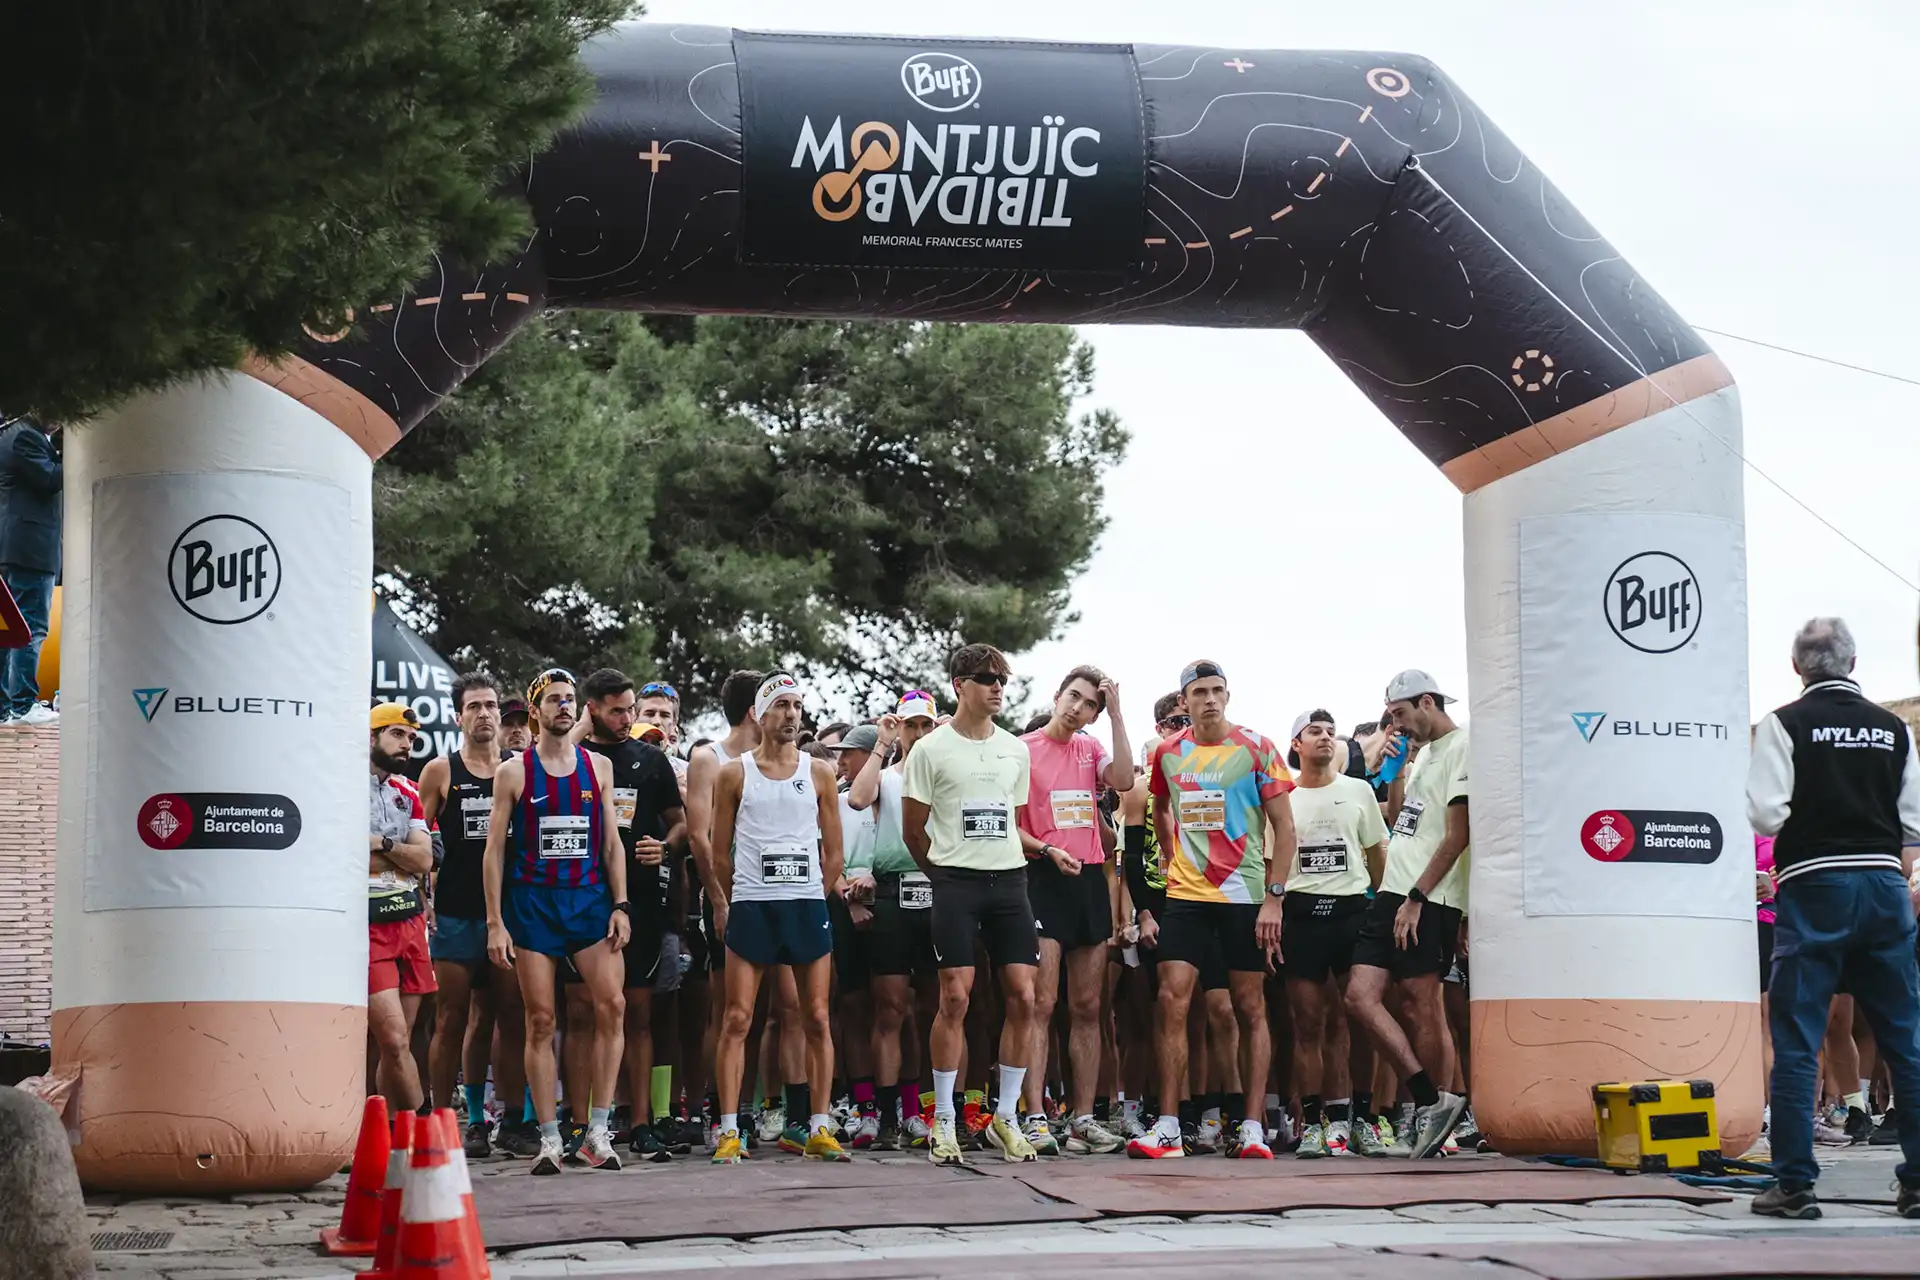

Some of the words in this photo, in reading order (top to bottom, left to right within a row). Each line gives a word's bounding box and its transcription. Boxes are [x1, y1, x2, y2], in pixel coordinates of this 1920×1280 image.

[790, 114, 1101, 178] MONTJUÏC
[862, 235, 923, 246] MEMORIAL
[925, 236, 983, 248] FRANCESC
[985, 238, 1023, 249] MATES
[376, 660, 451, 692] LIVE
[174, 696, 313, 718] BLUETTI
[1613, 720, 1728, 740] BLUETTI
[1811, 727, 1895, 745] MYLAPS
[410, 730, 465, 759] OW
[1180, 771, 1224, 783] RUNAWAY
[204, 805, 269, 819] Ajuntament
[270, 806, 284, 818] de
[204, 819, 284, 834] Barcelona
[975, 820, 1000, 830] 2578
[1644, 822, 1699, 834] Ajuntament
[1700, 824, 1711, 834] de
[551, 839, 580, 849] 2643
[1644, 835, 1711, 850] Barcelona
[1310, 856, 1337, 867] 2228
[774, 865, 800, 876] 2001
